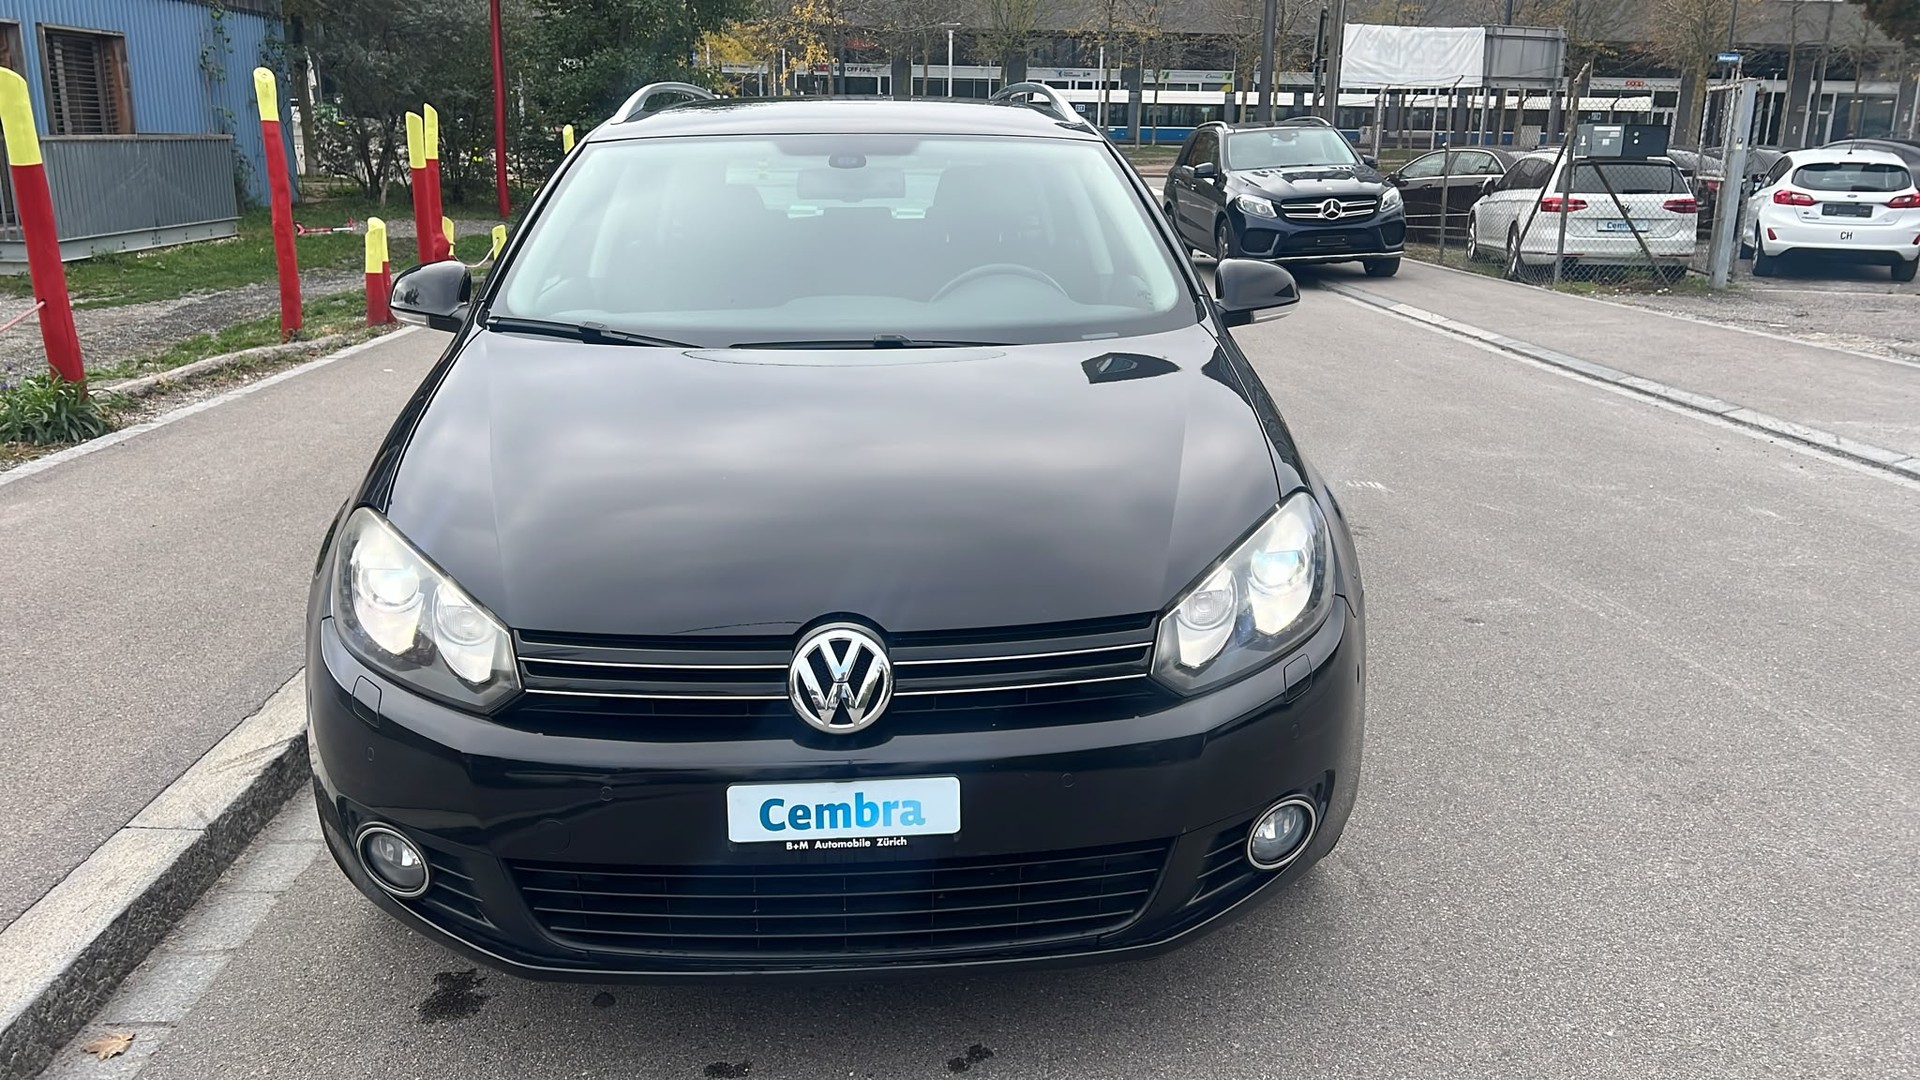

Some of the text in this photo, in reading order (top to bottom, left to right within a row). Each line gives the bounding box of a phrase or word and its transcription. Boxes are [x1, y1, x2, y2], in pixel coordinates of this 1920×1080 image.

[1840, 231, 1853, 240] CH
[759, 792, 926, 832] Cembra
[786, 836, 908, 851] B+M Automobile Zürich
